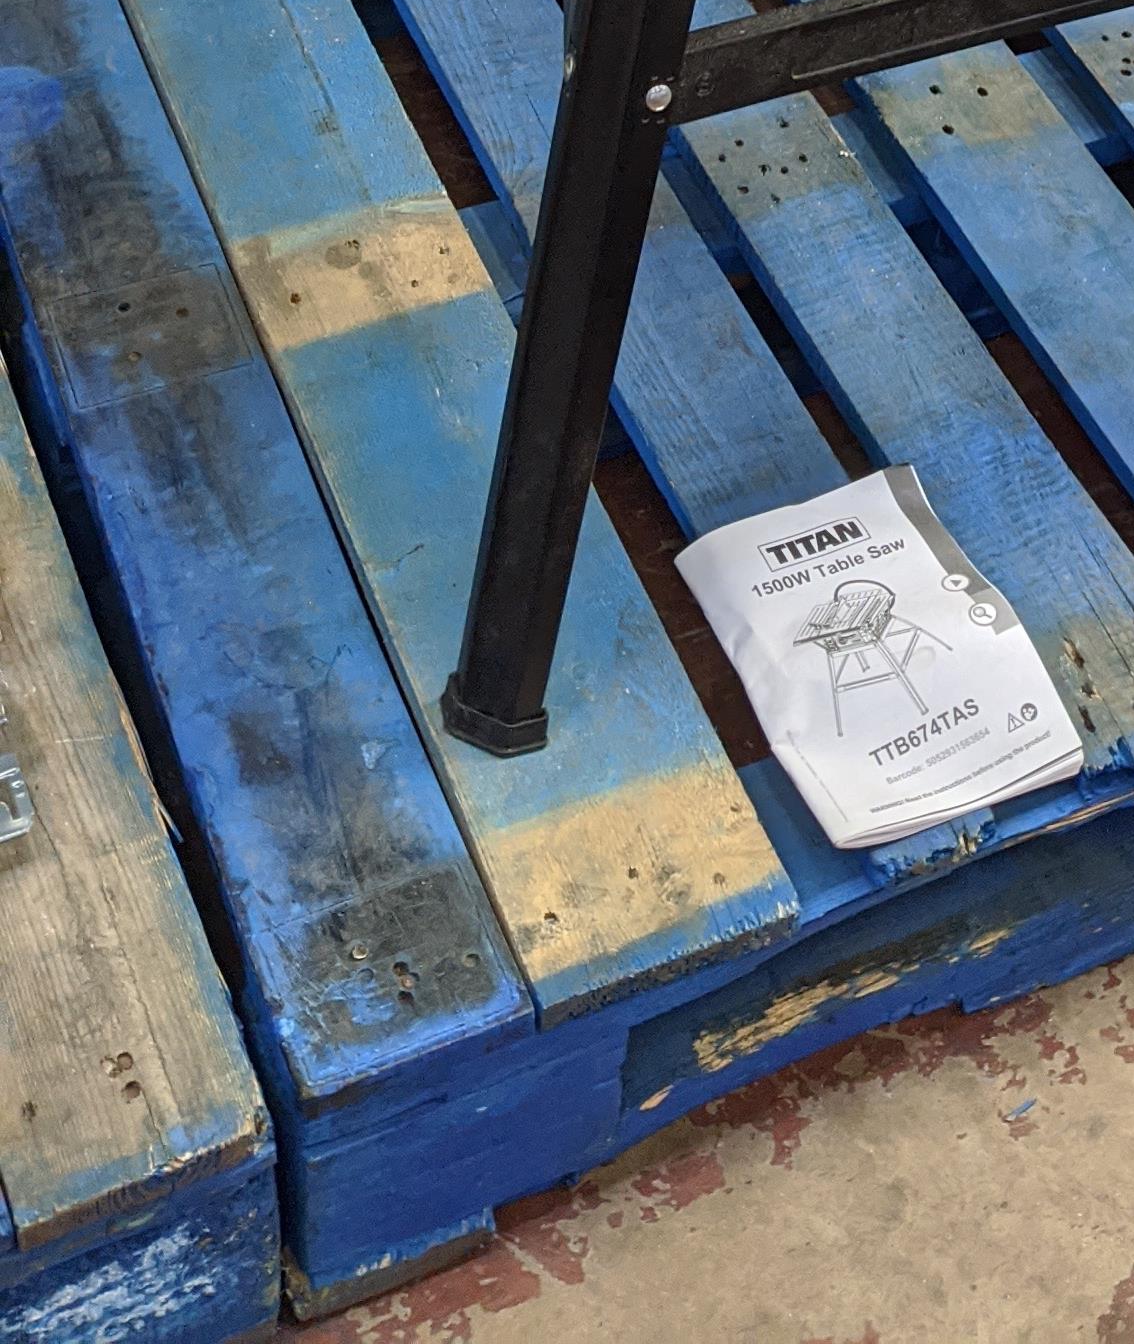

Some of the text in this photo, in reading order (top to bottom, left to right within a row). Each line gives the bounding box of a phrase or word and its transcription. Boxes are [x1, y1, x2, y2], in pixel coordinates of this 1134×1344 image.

[752, 538, 905, 597] 1500W Table Saw
[766, 521, 863, 564] TITAN
[868, 698, 979, 767] TTB674TAS
[886, 766, 924, 785] Barcode:
[934, 775, 972, 795] instructions
[972, 763, 994, 779] before
[994, 752, 1013, 765] using
[1012, 746, 1024, 755] the
[1023, 731, 1051, 751] product!
